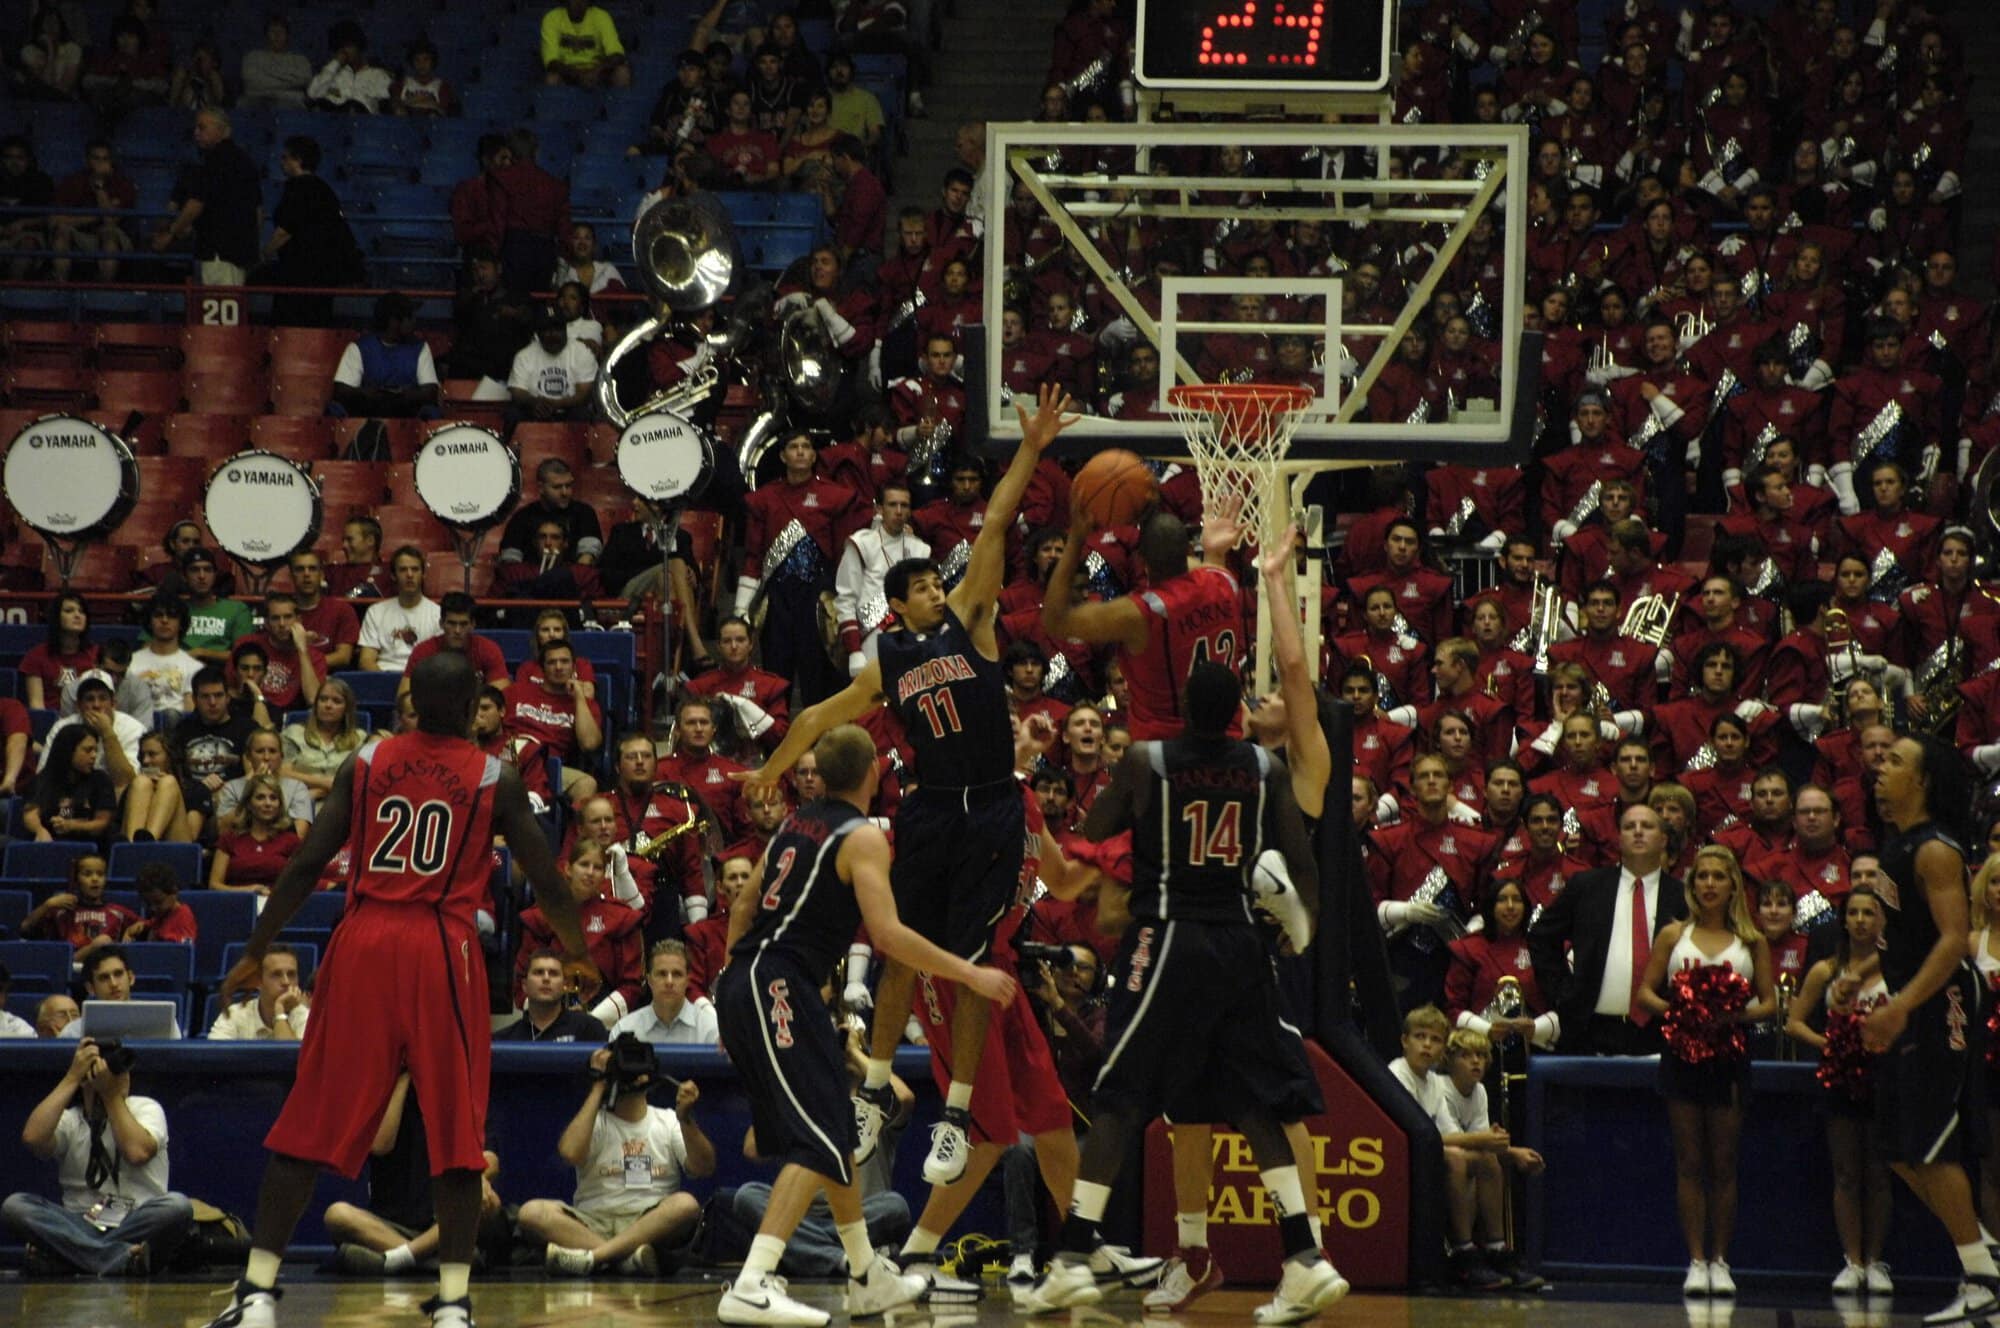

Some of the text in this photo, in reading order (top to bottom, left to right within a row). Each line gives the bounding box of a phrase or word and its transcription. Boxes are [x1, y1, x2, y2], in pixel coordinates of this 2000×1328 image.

[202, 298, 240, 327] 20
[43, 435, 96, 449] YAMAHA
[447, 441, 489, 456] YAMAHA
[642, 426, 685, 445] YAMAHA
[243, 469, 295, 487] YAMAHA
[898, 653, 978, 707] ARIZONA
[917, 686, 963, 739] 11
[368, 794, 453, 876] 20
[1182, 800, 1243, 867] 14
[762, 846, 796, 911] 2
[768, 977, 795, 1049] CATS
